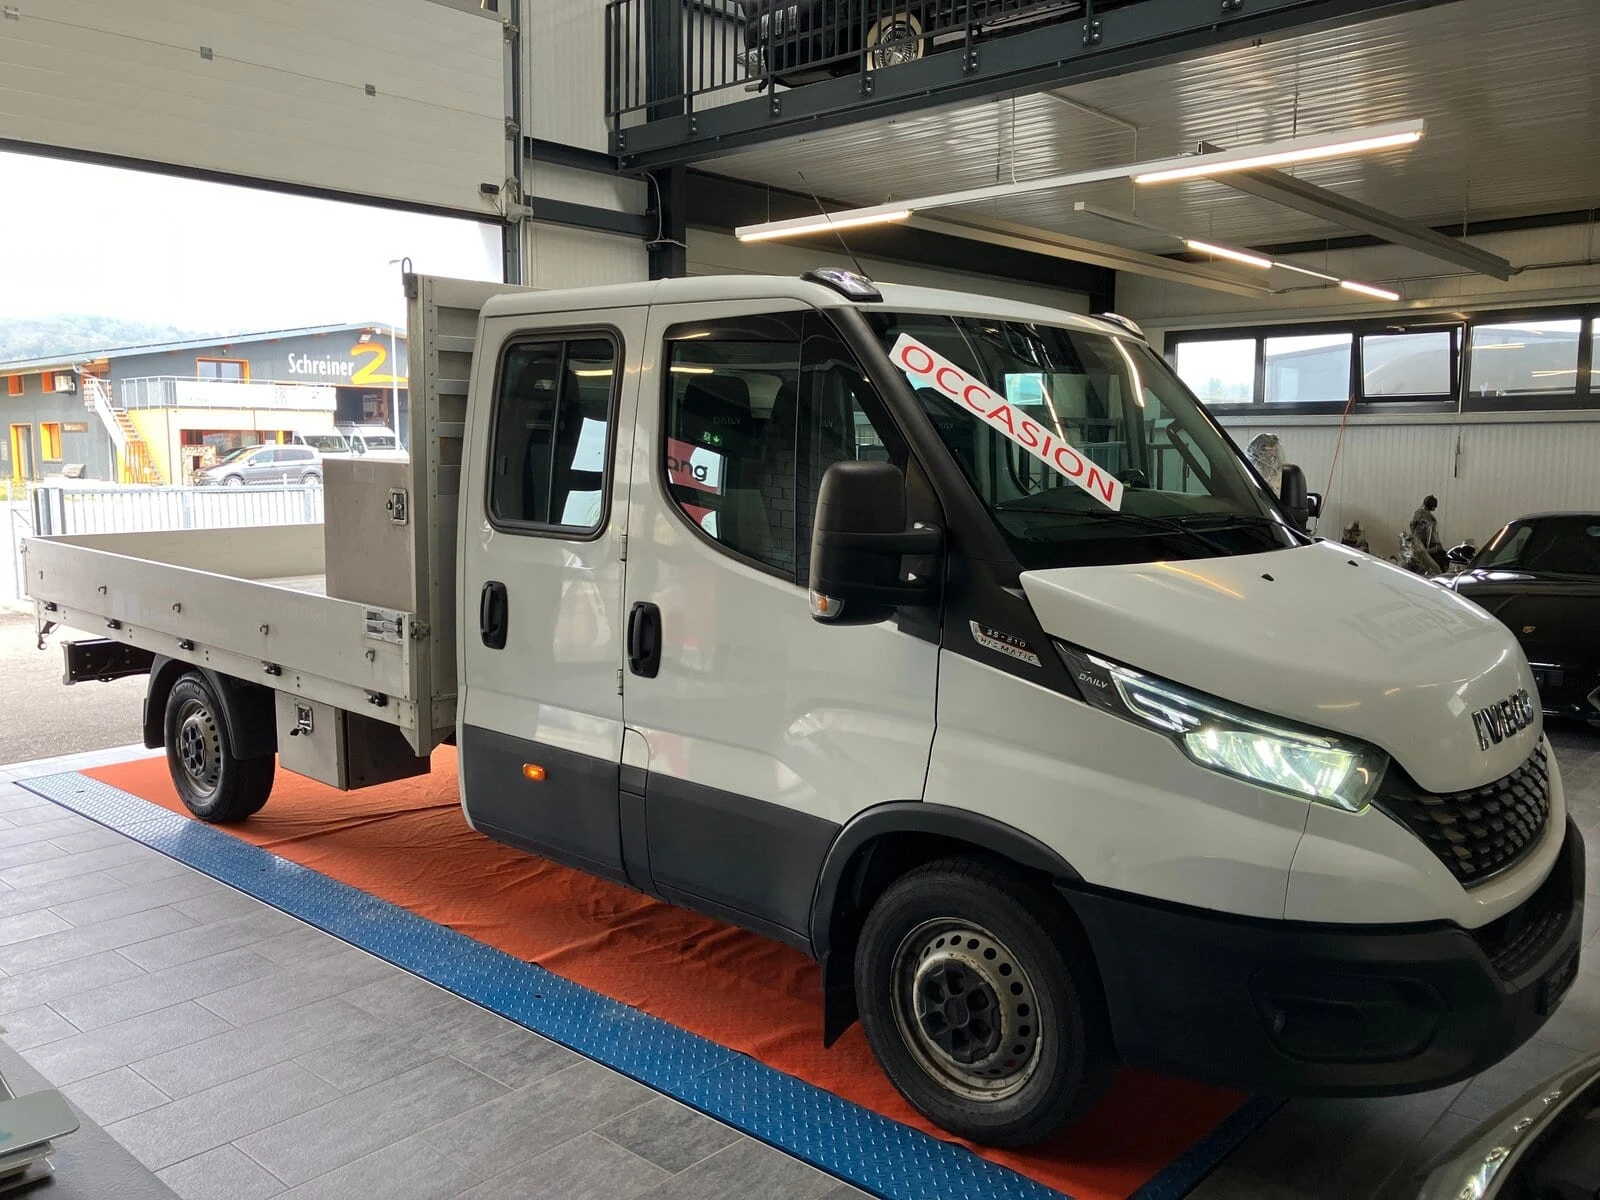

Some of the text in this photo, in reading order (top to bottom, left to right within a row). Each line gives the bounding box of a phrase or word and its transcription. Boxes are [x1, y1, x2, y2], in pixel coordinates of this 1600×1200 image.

[288, 342, 408, 385] Schreiner 2
[713, 416, 742, 425] DAILY
[901, 345, 1115, 502] OCCASION
[979, 637, 1035, 662] HI-MATIC
[1079, 672, 1108, 689] DAILY
[1471, 688, 1534, 751] IVECO
